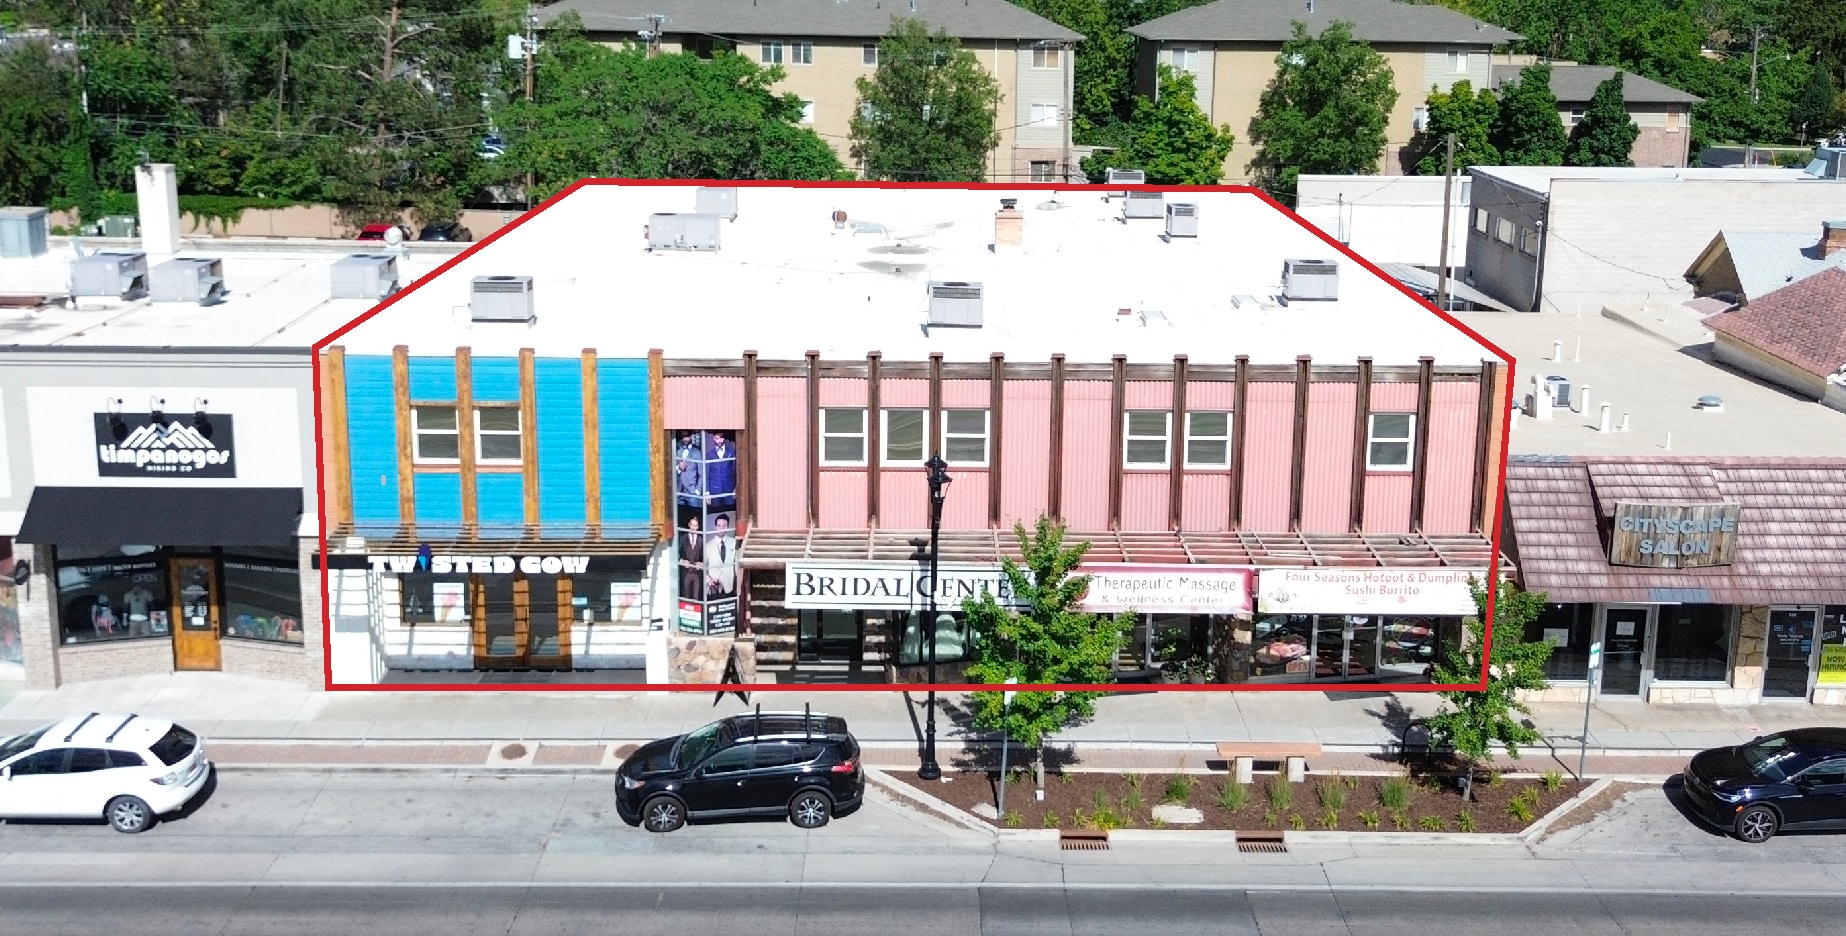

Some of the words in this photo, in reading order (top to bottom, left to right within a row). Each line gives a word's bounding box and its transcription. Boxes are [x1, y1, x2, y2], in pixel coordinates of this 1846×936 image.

[99, 443, 230, 469] timpanogos
[1619, 516, 1735, 534] CITYSCAPE
[1639, 539, 1709, 556] SALON
[519, 555, 591, 574] COW
[791, 572, 910, 598] BRIDAL
[916, 575, 1018, 599] CENTE
[1094, 575, 1173, 592] Therapeutic
[1179, 577, 1236, 594] Massage
[1285, 571, 1310, 582] Four
[1314, 571, 1361, 583] Seasons
[1364, 572, 1404, 585] Hotpot
[1408, 572, 1415, 583] &
[1345, 585, 1376, 595] Sushi
[1379, 585, 1420, 595] Burrito
[1101, 595, 1110, 604] &
[1116, 595, 1174, 604] Wellness
[1180, 595, 1223, 605] Center
[1827, 655, 1846, 663] NOW
